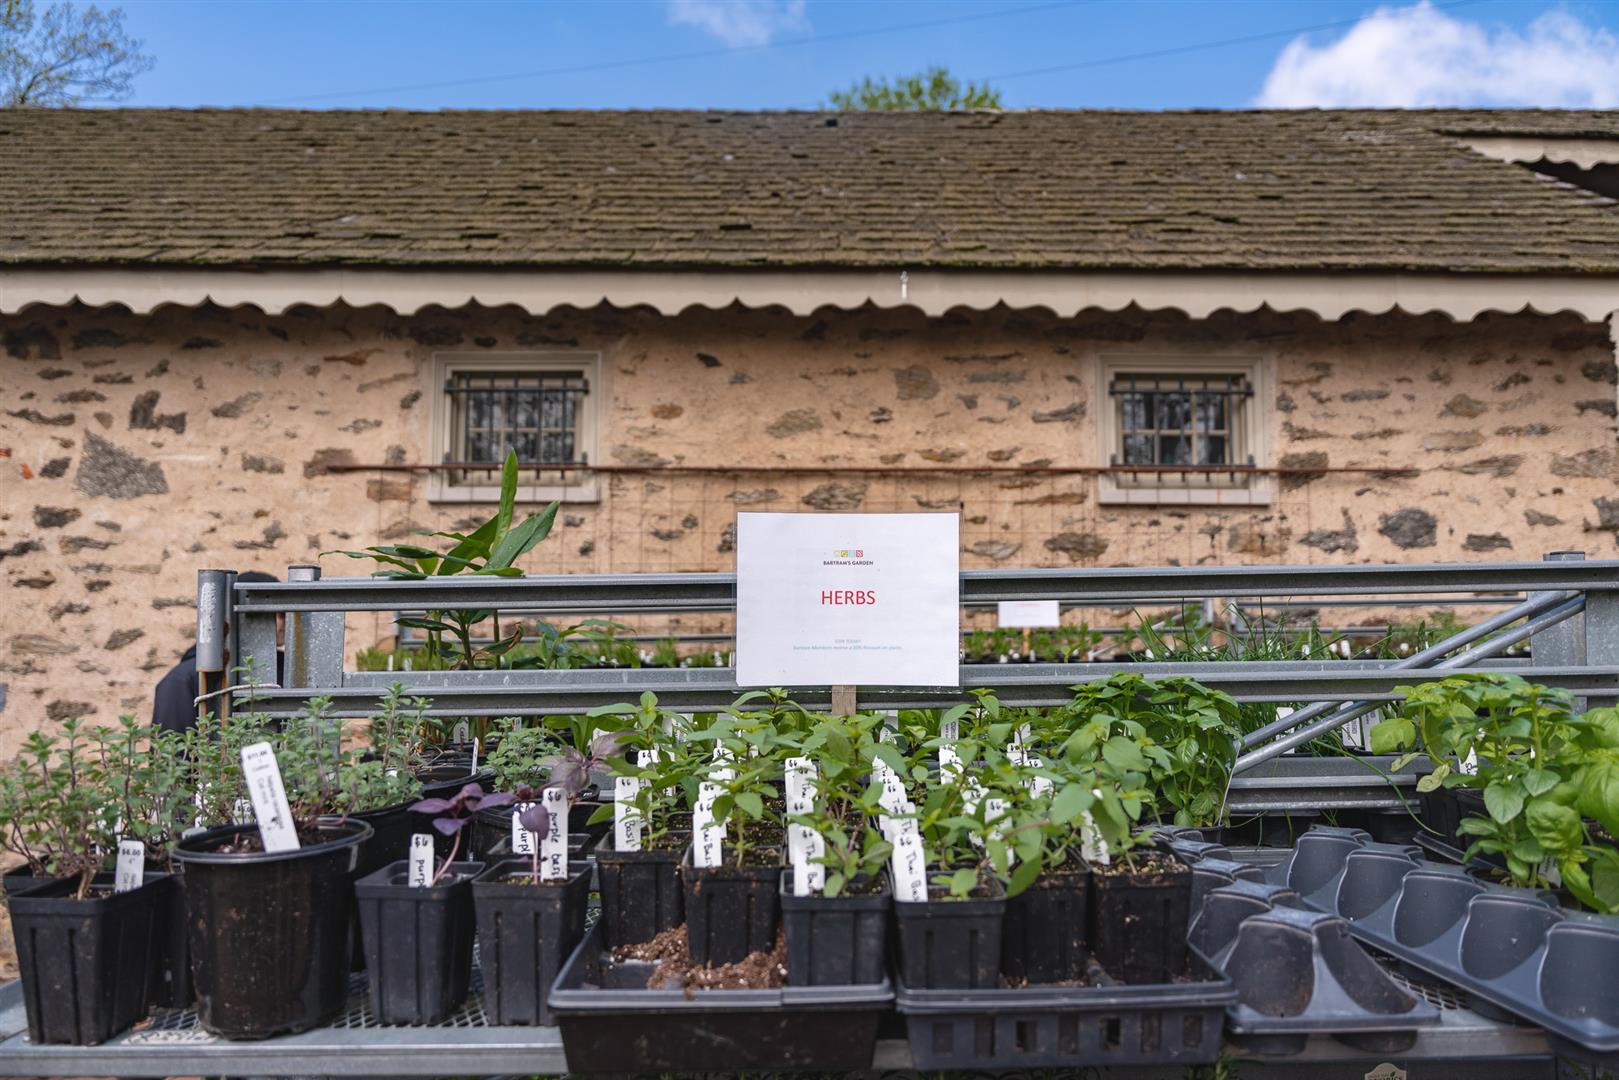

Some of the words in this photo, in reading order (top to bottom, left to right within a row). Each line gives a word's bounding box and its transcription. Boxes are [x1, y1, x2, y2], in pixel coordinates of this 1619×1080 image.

[821, 590, 876, 605] HERBS
[547, 789, 562, 803] $6
[415, 836, 428, 848] $6
